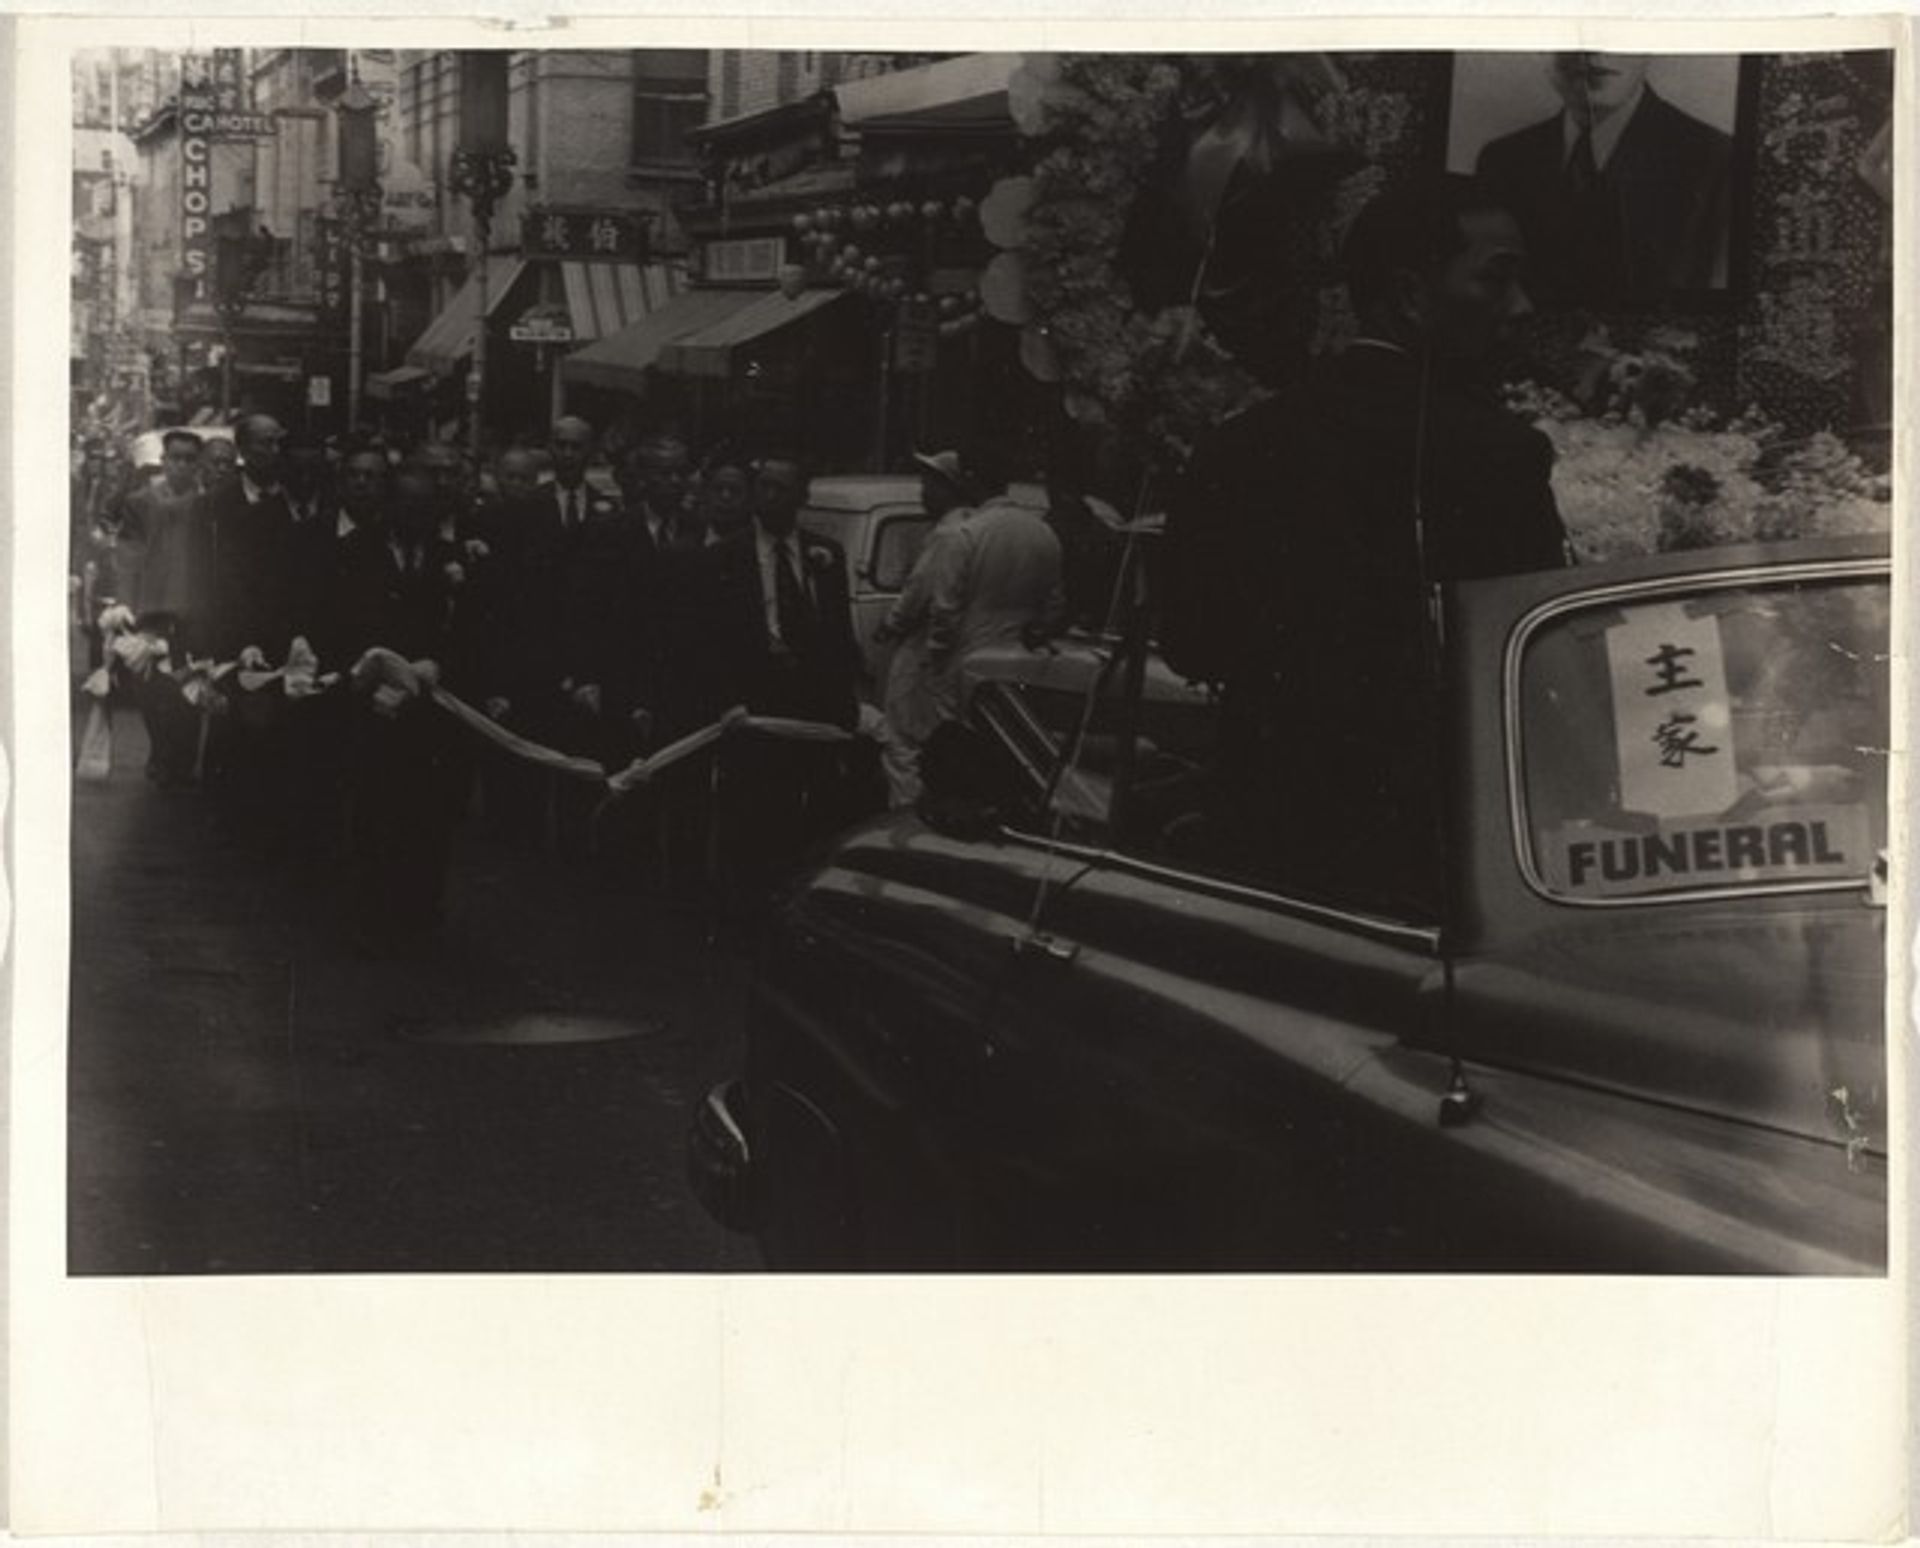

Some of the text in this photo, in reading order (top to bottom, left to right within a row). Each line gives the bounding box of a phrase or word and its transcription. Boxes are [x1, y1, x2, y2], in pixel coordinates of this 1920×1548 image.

[216, 117, 276, 133] HOTEL
[185, 137, 207, 239] CHOP
[1645, 643, 1719, 768] 主家
[1568, 820, 1845, 886] FUNERAL
